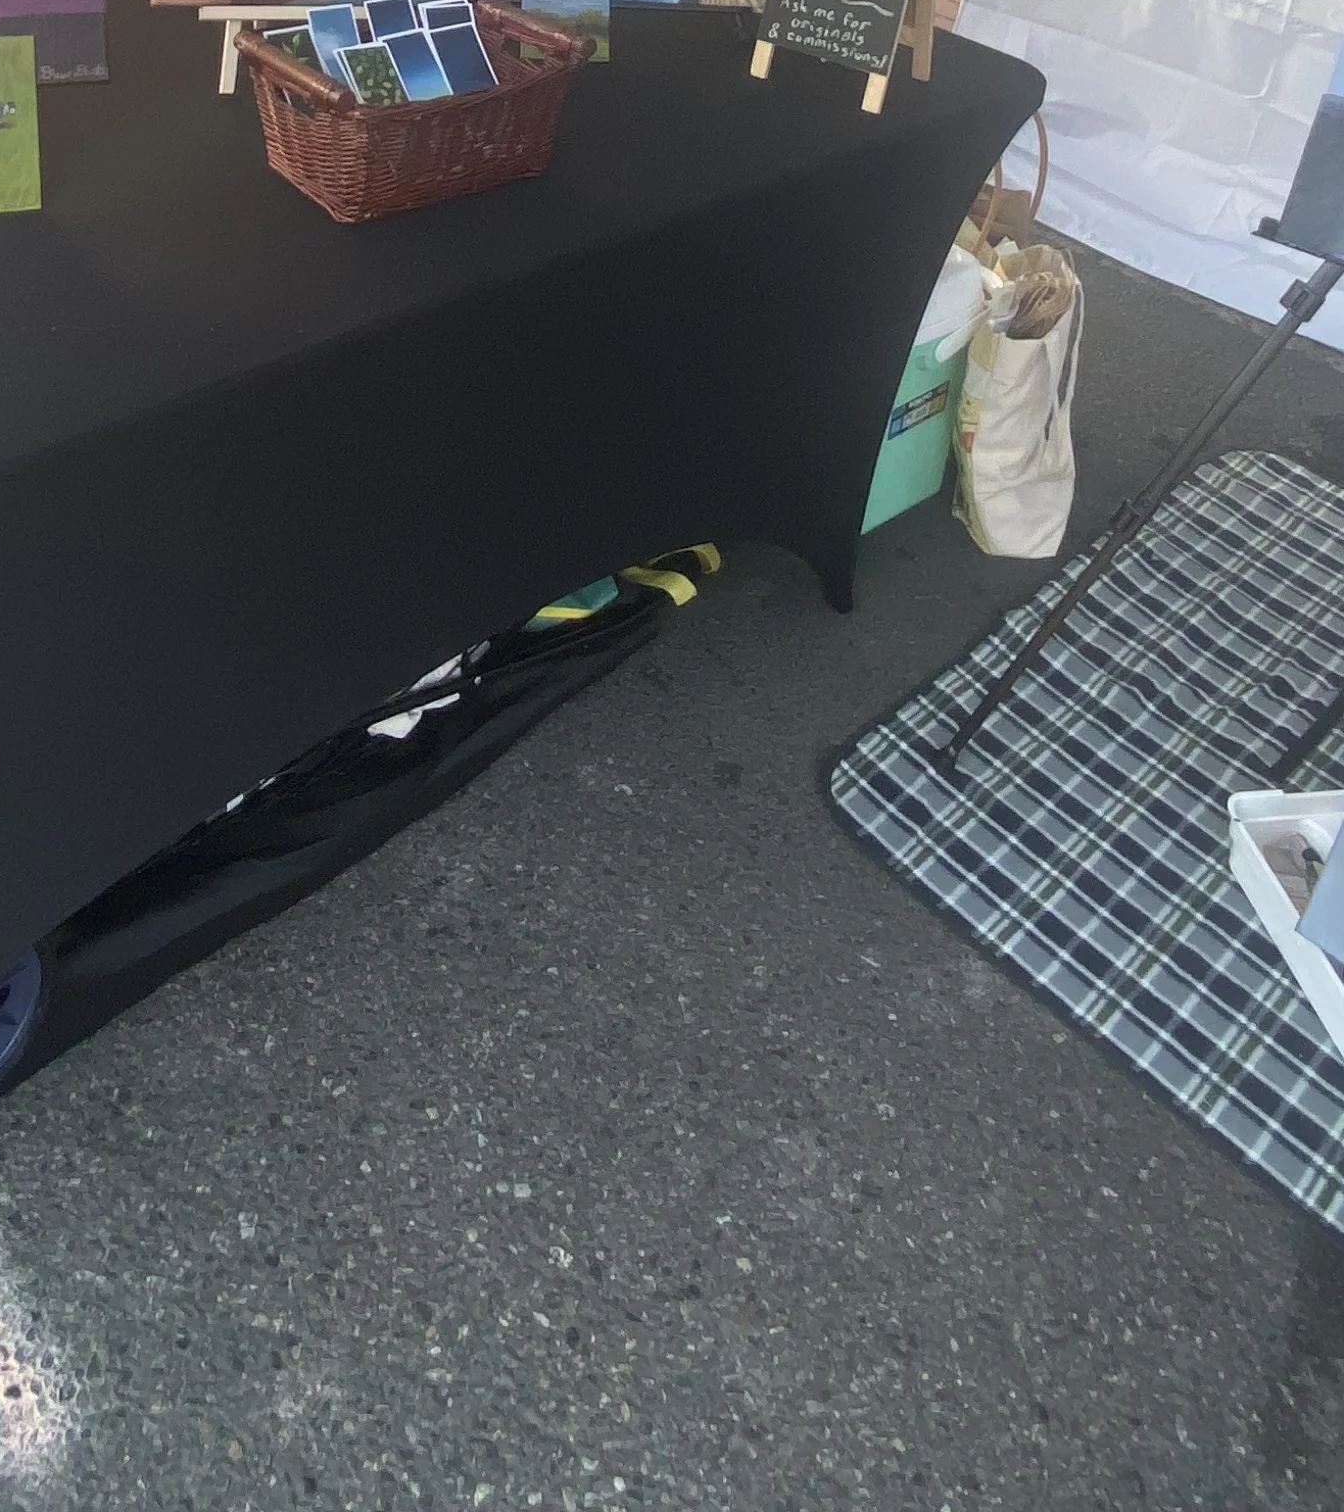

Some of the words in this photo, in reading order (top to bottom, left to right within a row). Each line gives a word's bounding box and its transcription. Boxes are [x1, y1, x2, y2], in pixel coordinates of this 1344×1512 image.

[791, 17, 866, 45] originals
[813, 7, 836, 21] me
[843, 11, 872, 31] for
[768, 23, 781, 39] &
[786, 30, 889, 69] commissions!
